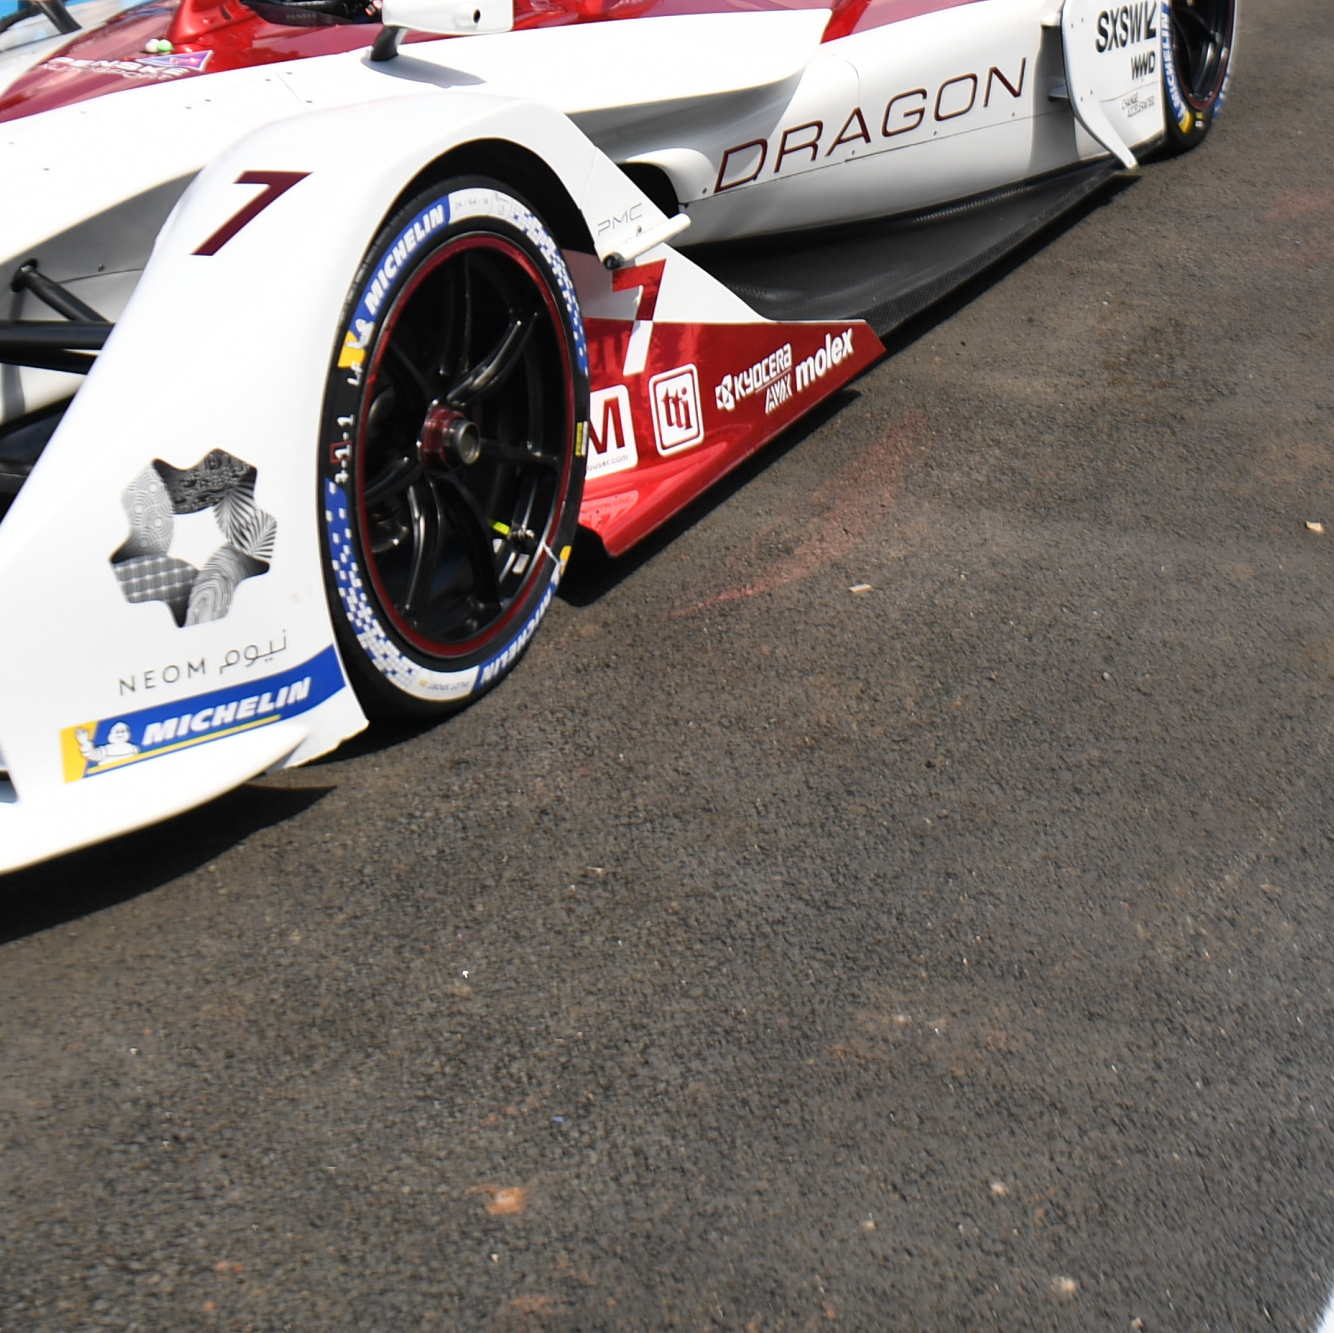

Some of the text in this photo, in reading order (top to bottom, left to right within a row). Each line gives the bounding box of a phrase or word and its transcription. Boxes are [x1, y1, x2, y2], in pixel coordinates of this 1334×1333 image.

[1095, 0, 1145, 54] SXSW
[713, 57, 1027, 195] DRAGON
[189, 170, 315, 256] 7
[597, 203, 643, 237] PMC
[363, 203, 446, 317] MICHELIN
[733, 343, 793, 402] KYOCERA
[795, 327, 855, 393] molex
[588, 396, 626, 455] M
[587, 454, 630, 472] ouser.com
[119, 657, 207, 697] NEOM
[219, 629, 288, 675] نيوم
[141, 676, 313, 747] MICHELIN
